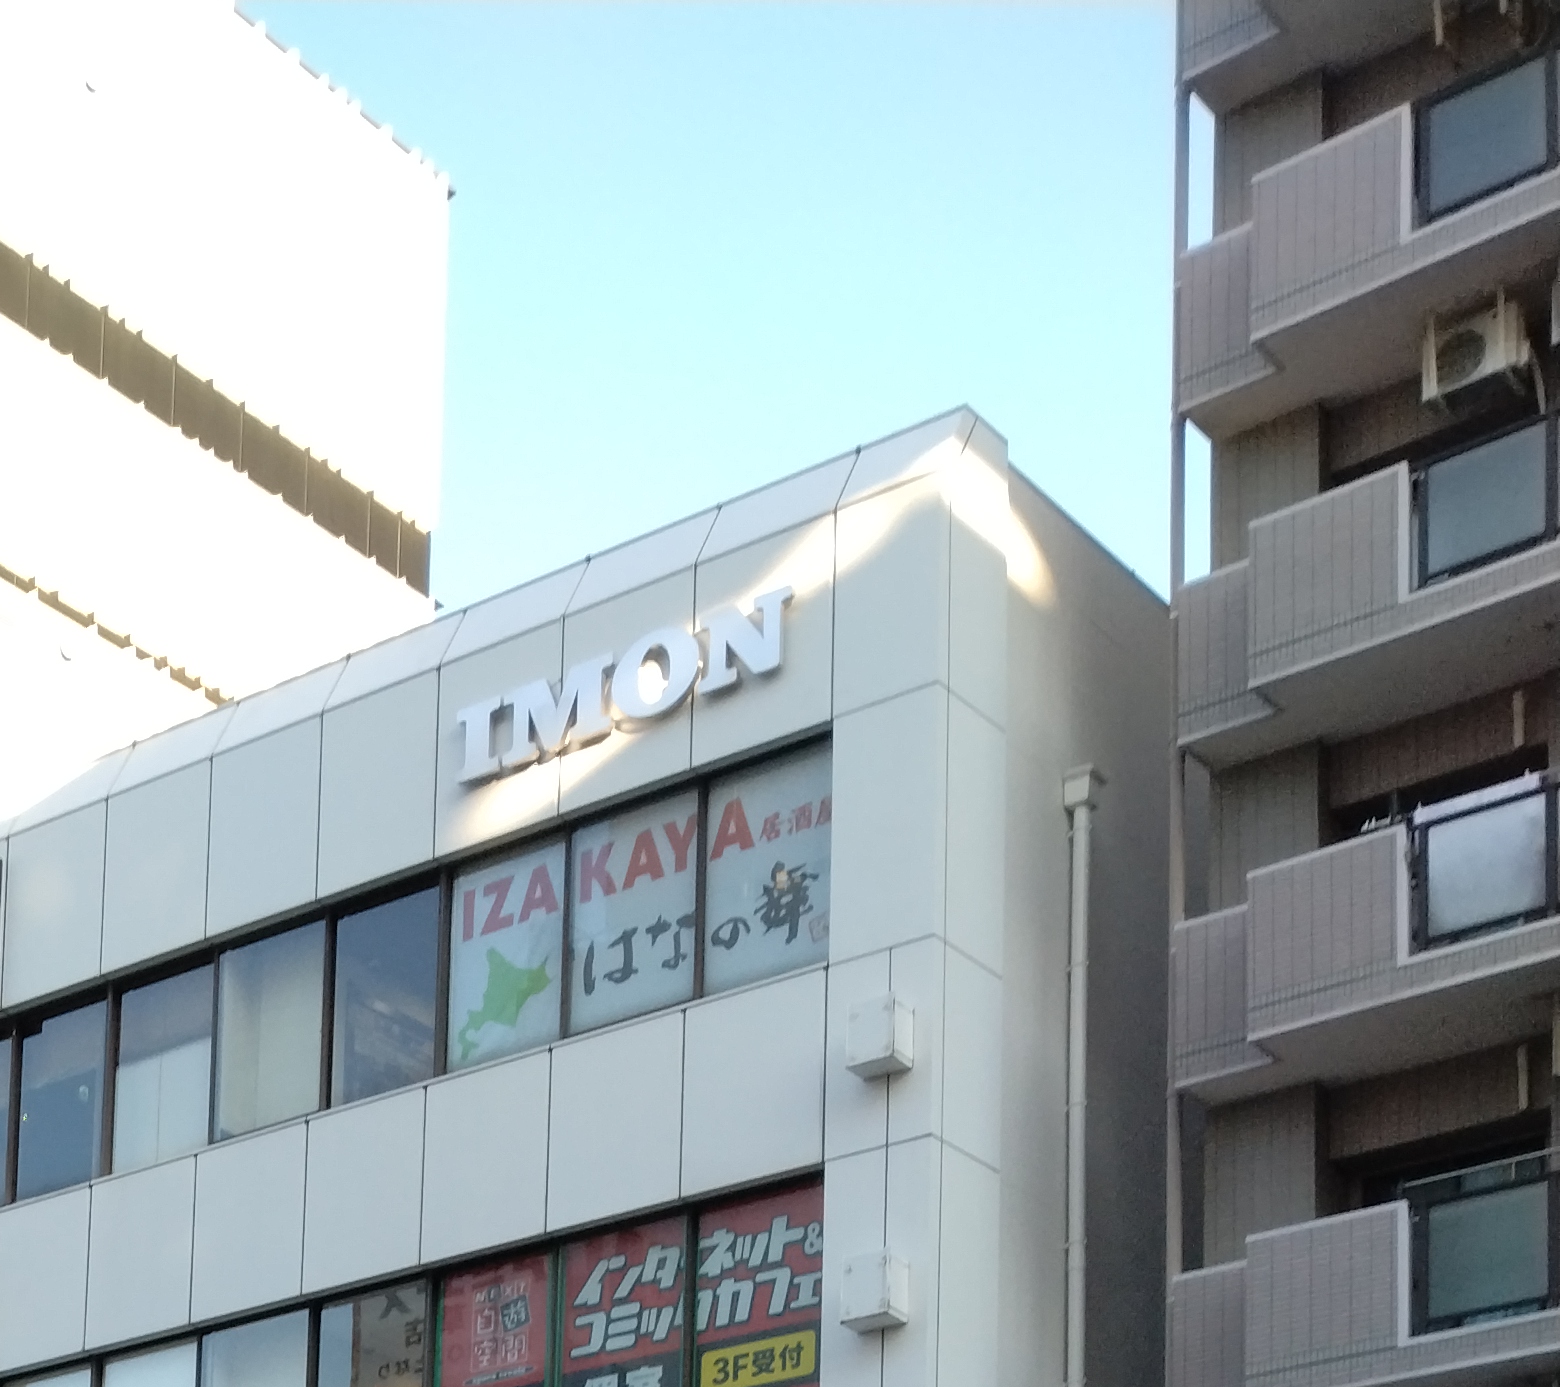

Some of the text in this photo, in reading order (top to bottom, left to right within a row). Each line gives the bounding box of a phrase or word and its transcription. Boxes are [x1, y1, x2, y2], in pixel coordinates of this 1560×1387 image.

[456, 586, 792, 784] IMON
[459, 797, 755, 943] IZAKAYA
[711, 1341, 804, 1386] 3F受付
